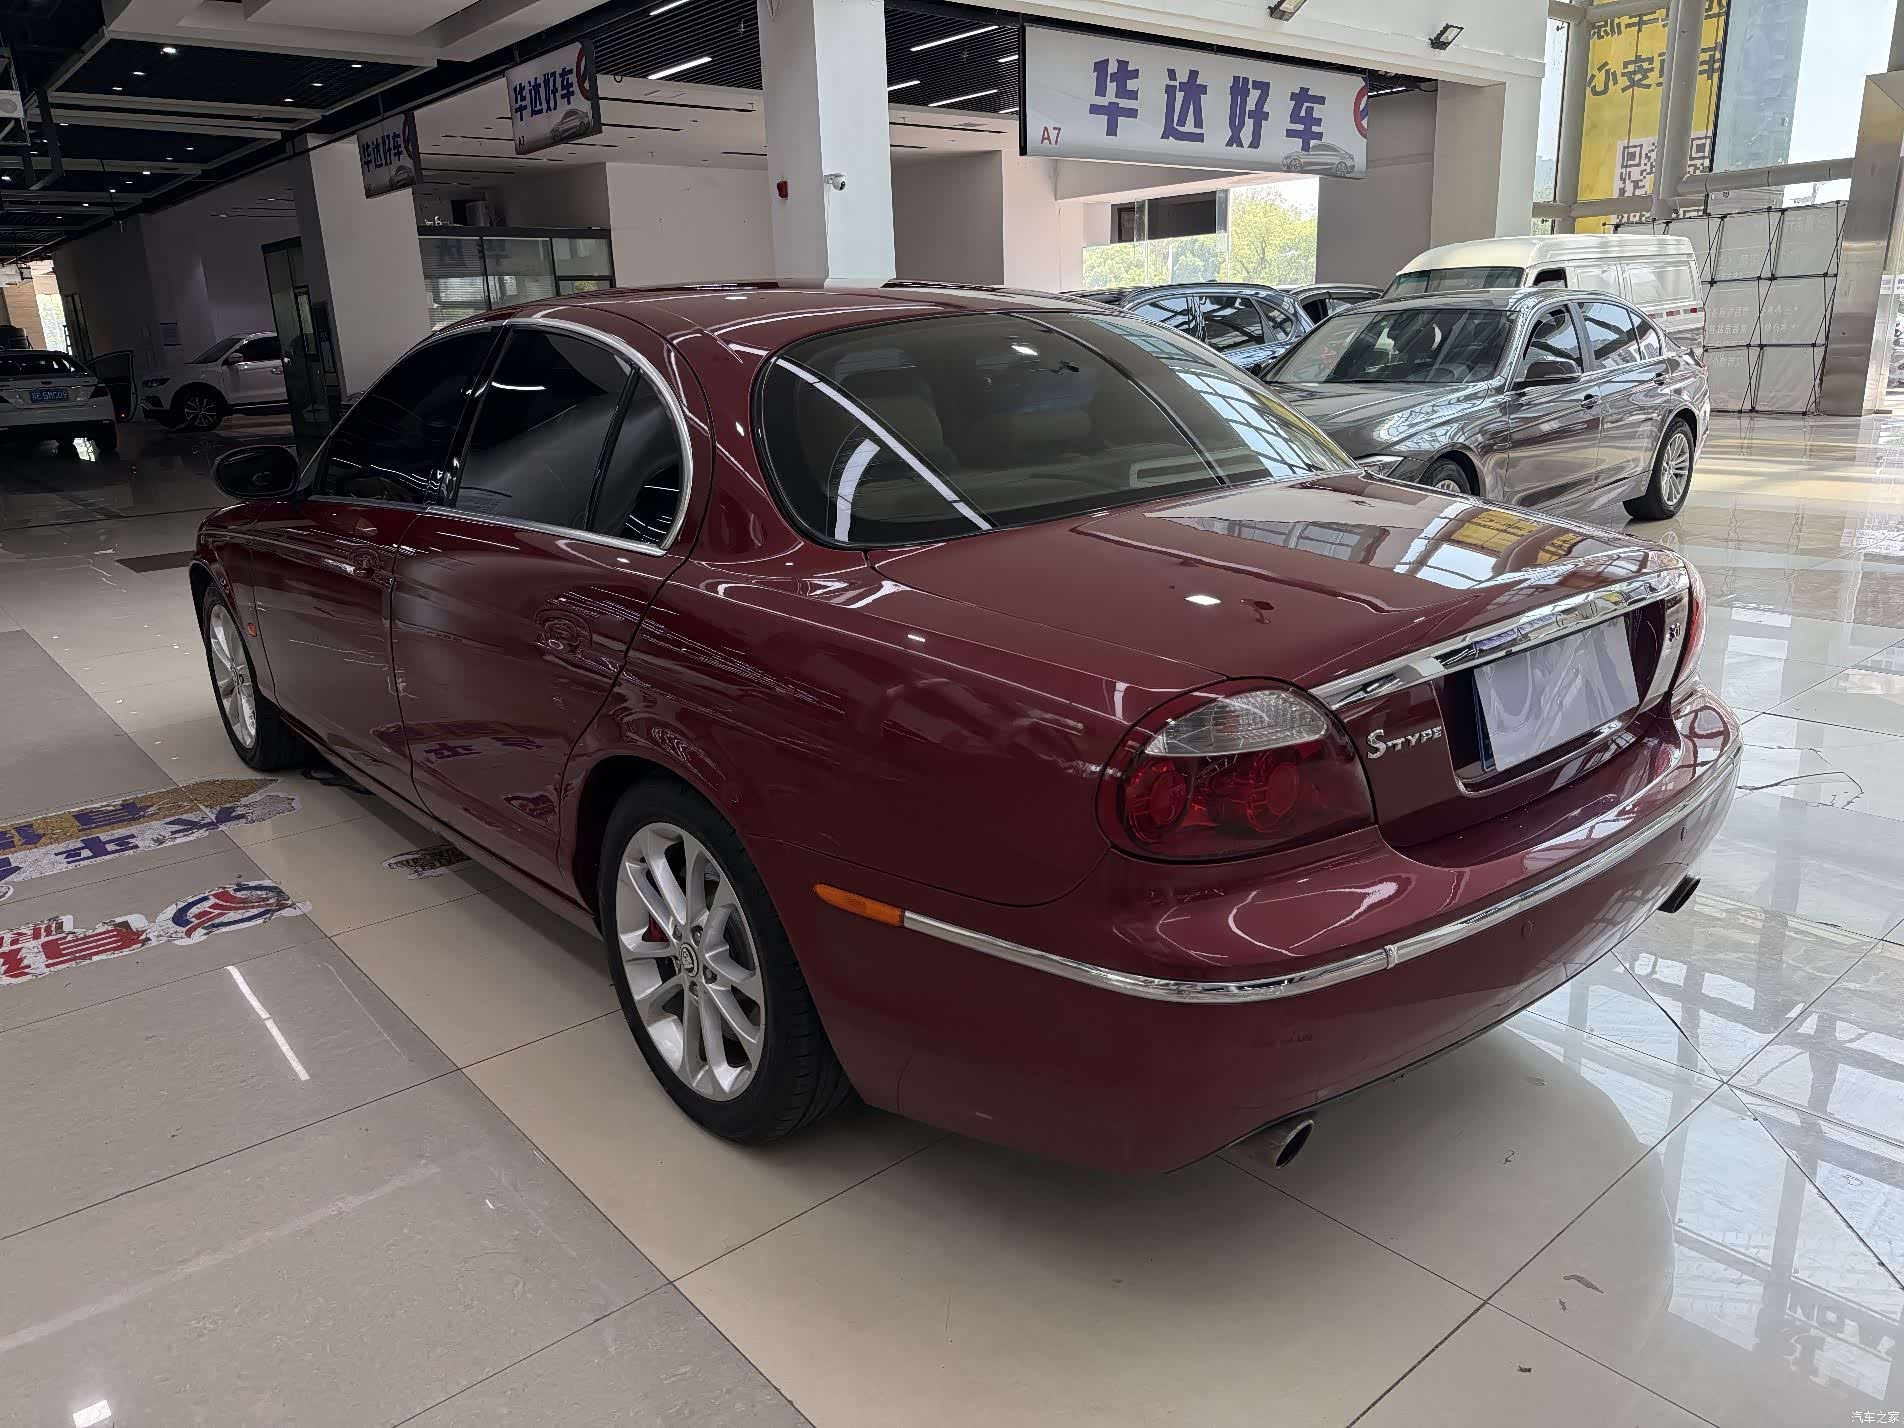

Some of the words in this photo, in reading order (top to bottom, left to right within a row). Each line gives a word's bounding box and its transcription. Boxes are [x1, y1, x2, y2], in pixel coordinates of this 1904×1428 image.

[513, 67, 576, 122] 华达好车
[1089, 58, 1327, 153] 华达好车
[362, 132, 403, 172] 华达好车
[1041, 126, 1062, 146] A7
